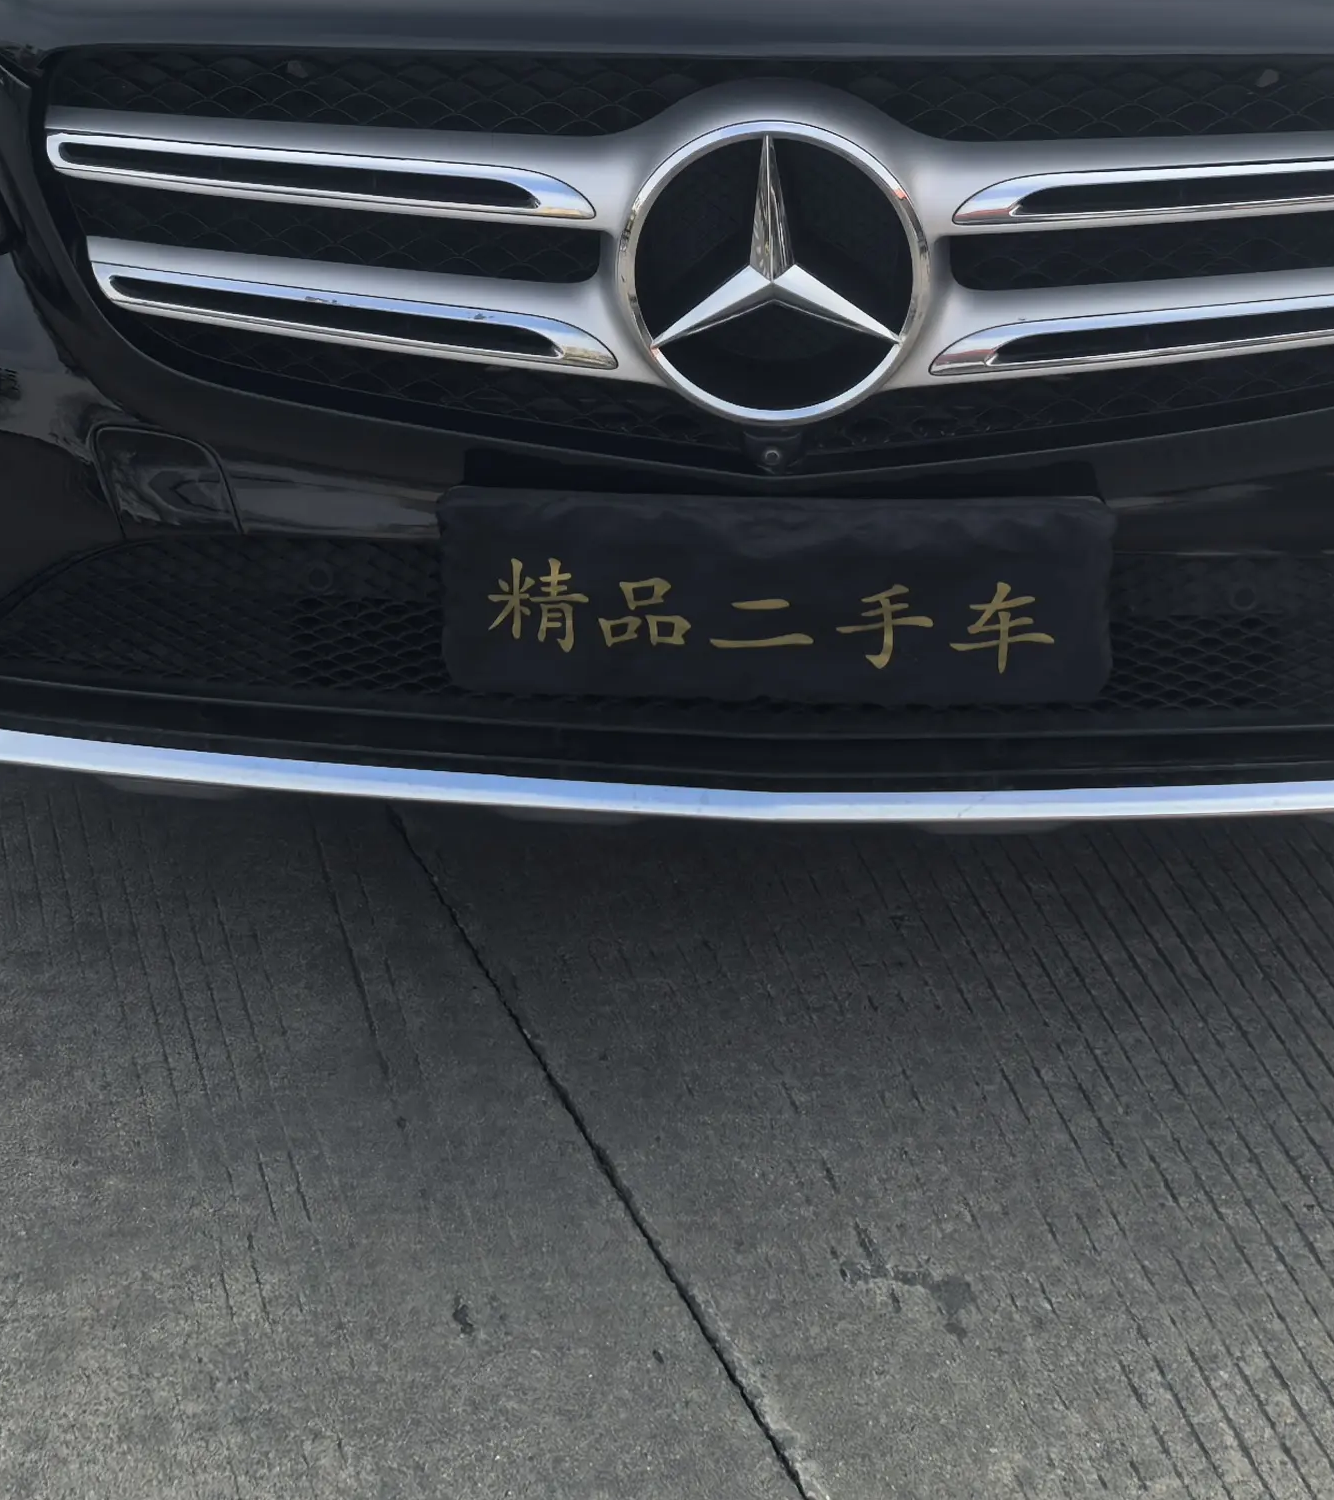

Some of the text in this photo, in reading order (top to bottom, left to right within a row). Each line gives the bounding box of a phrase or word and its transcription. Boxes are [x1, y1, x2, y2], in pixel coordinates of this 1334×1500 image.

[487, 557, 1055, 674] 精品二手车
